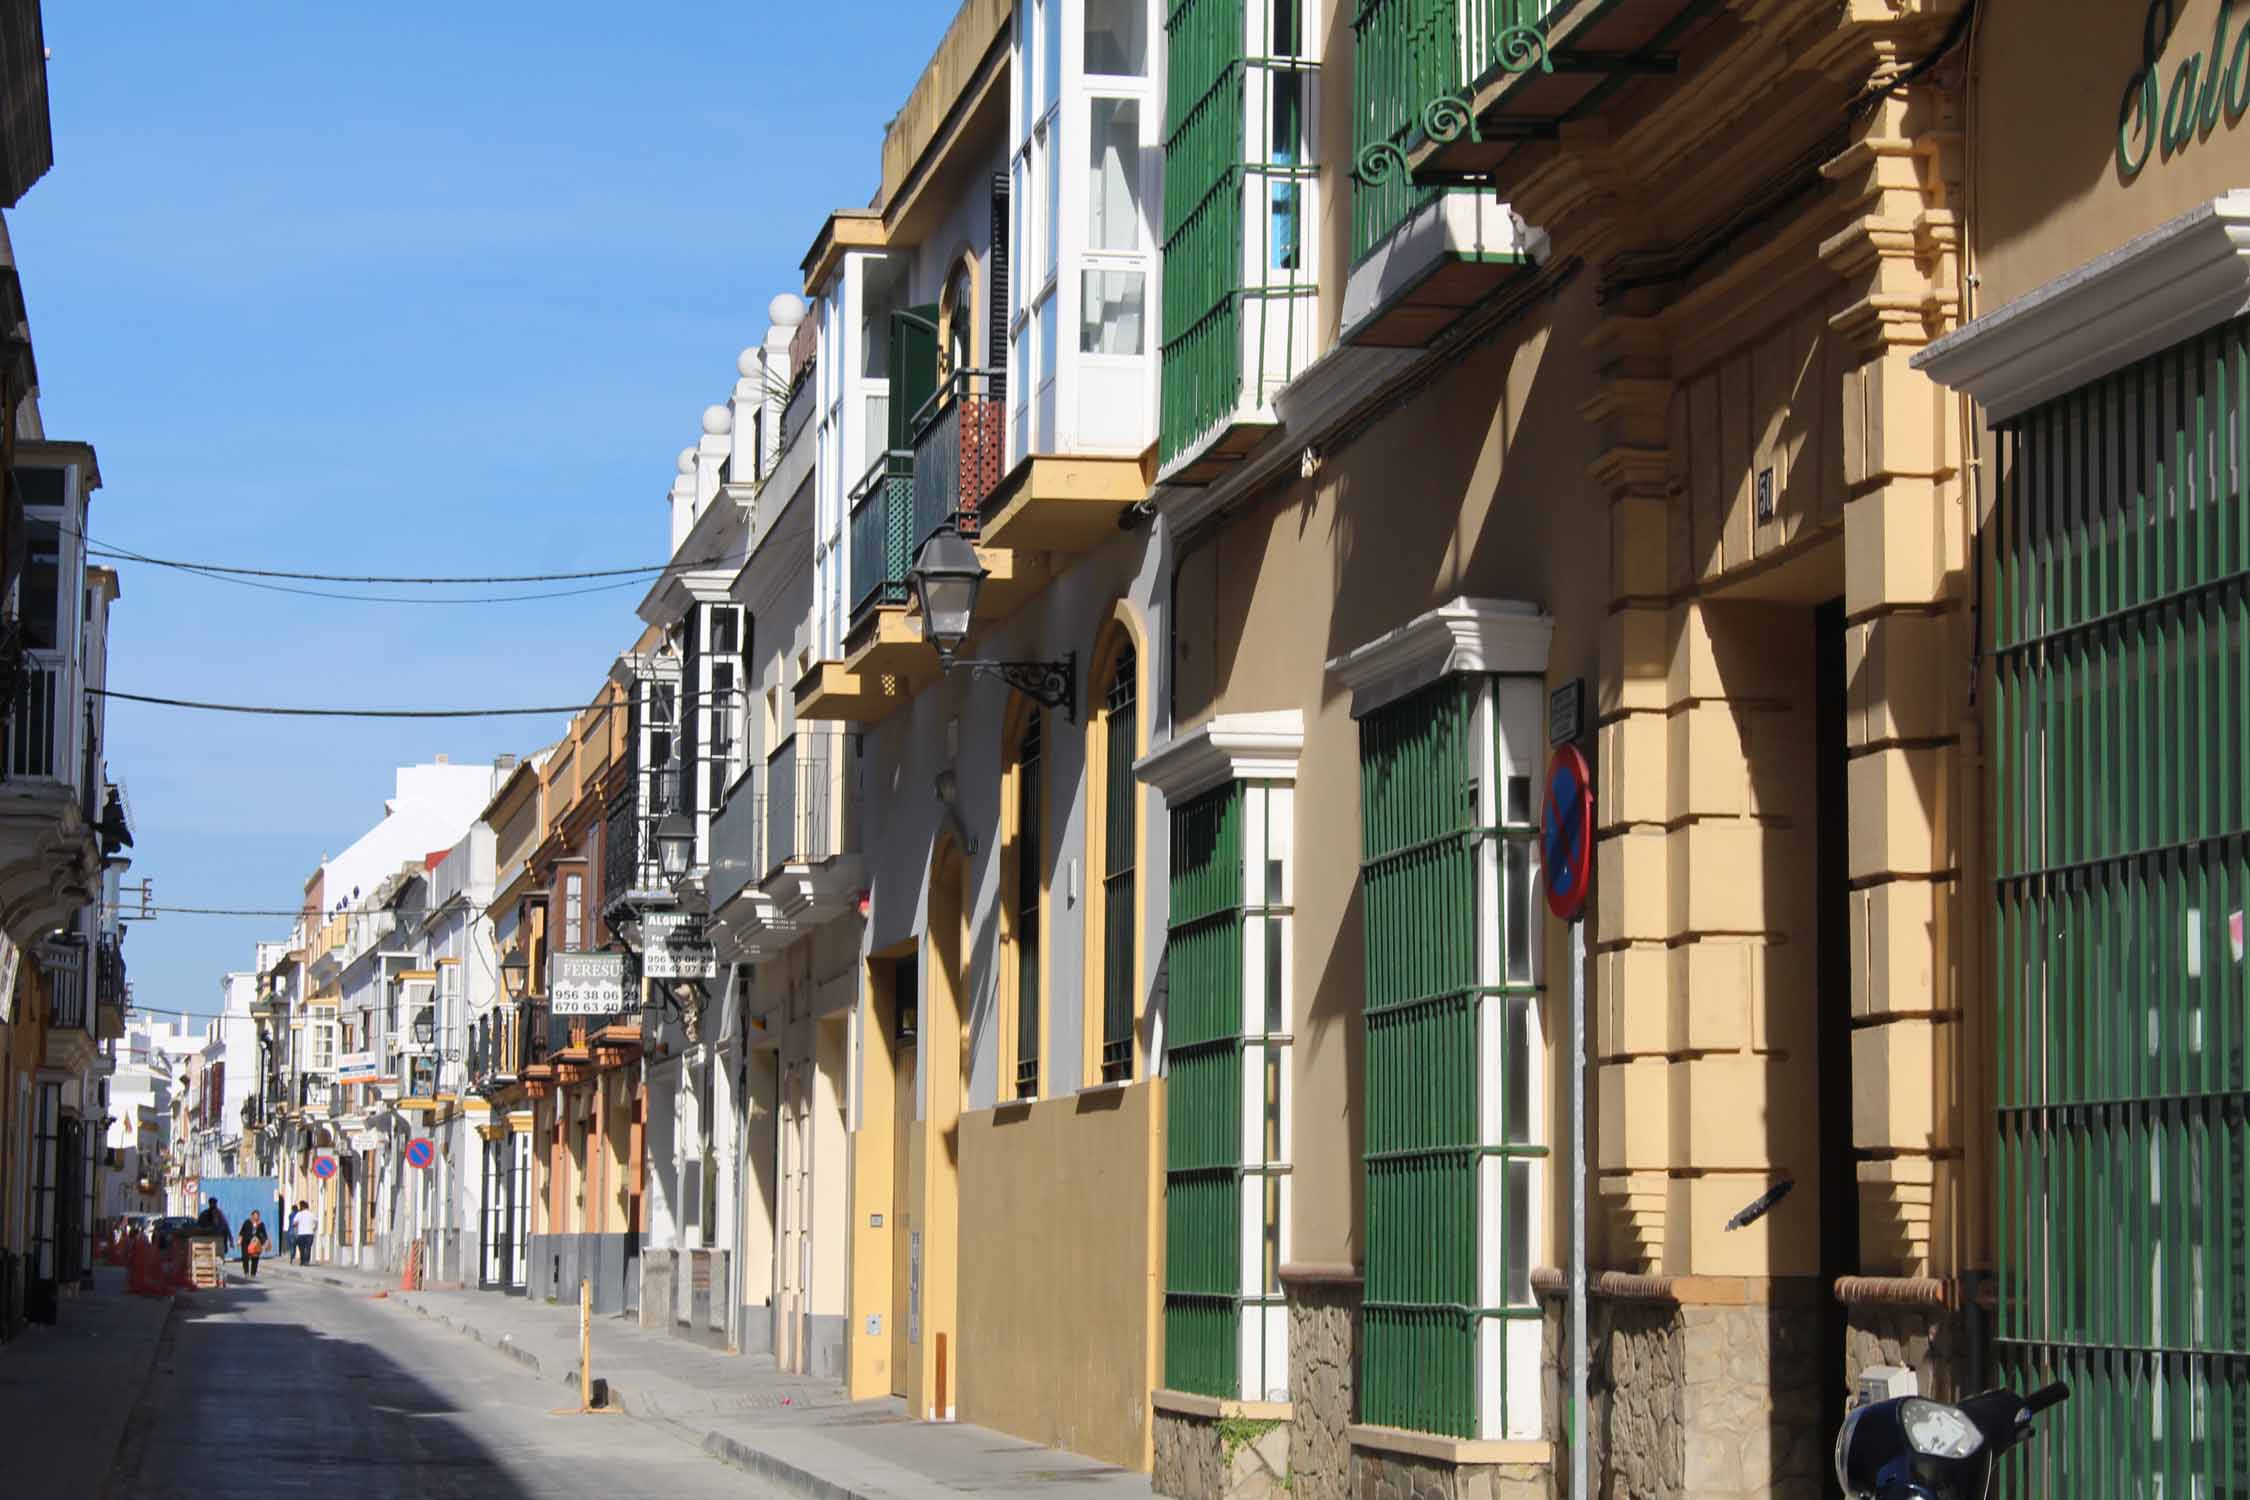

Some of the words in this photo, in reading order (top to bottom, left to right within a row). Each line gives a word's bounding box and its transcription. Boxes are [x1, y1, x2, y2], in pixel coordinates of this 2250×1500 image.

[647, 954, 666, 963] 956
[555, 990, 579, 1001] 956
[583, 990, 599, 1001] 38
[602, 990, 619, 1001] 06
[555, 1001, 579, 1012] 670
[583, 1001, 599, 1012] 63
[602, 1001, 619, 1012] 40
[623, 1001, 639, 1012] 46
